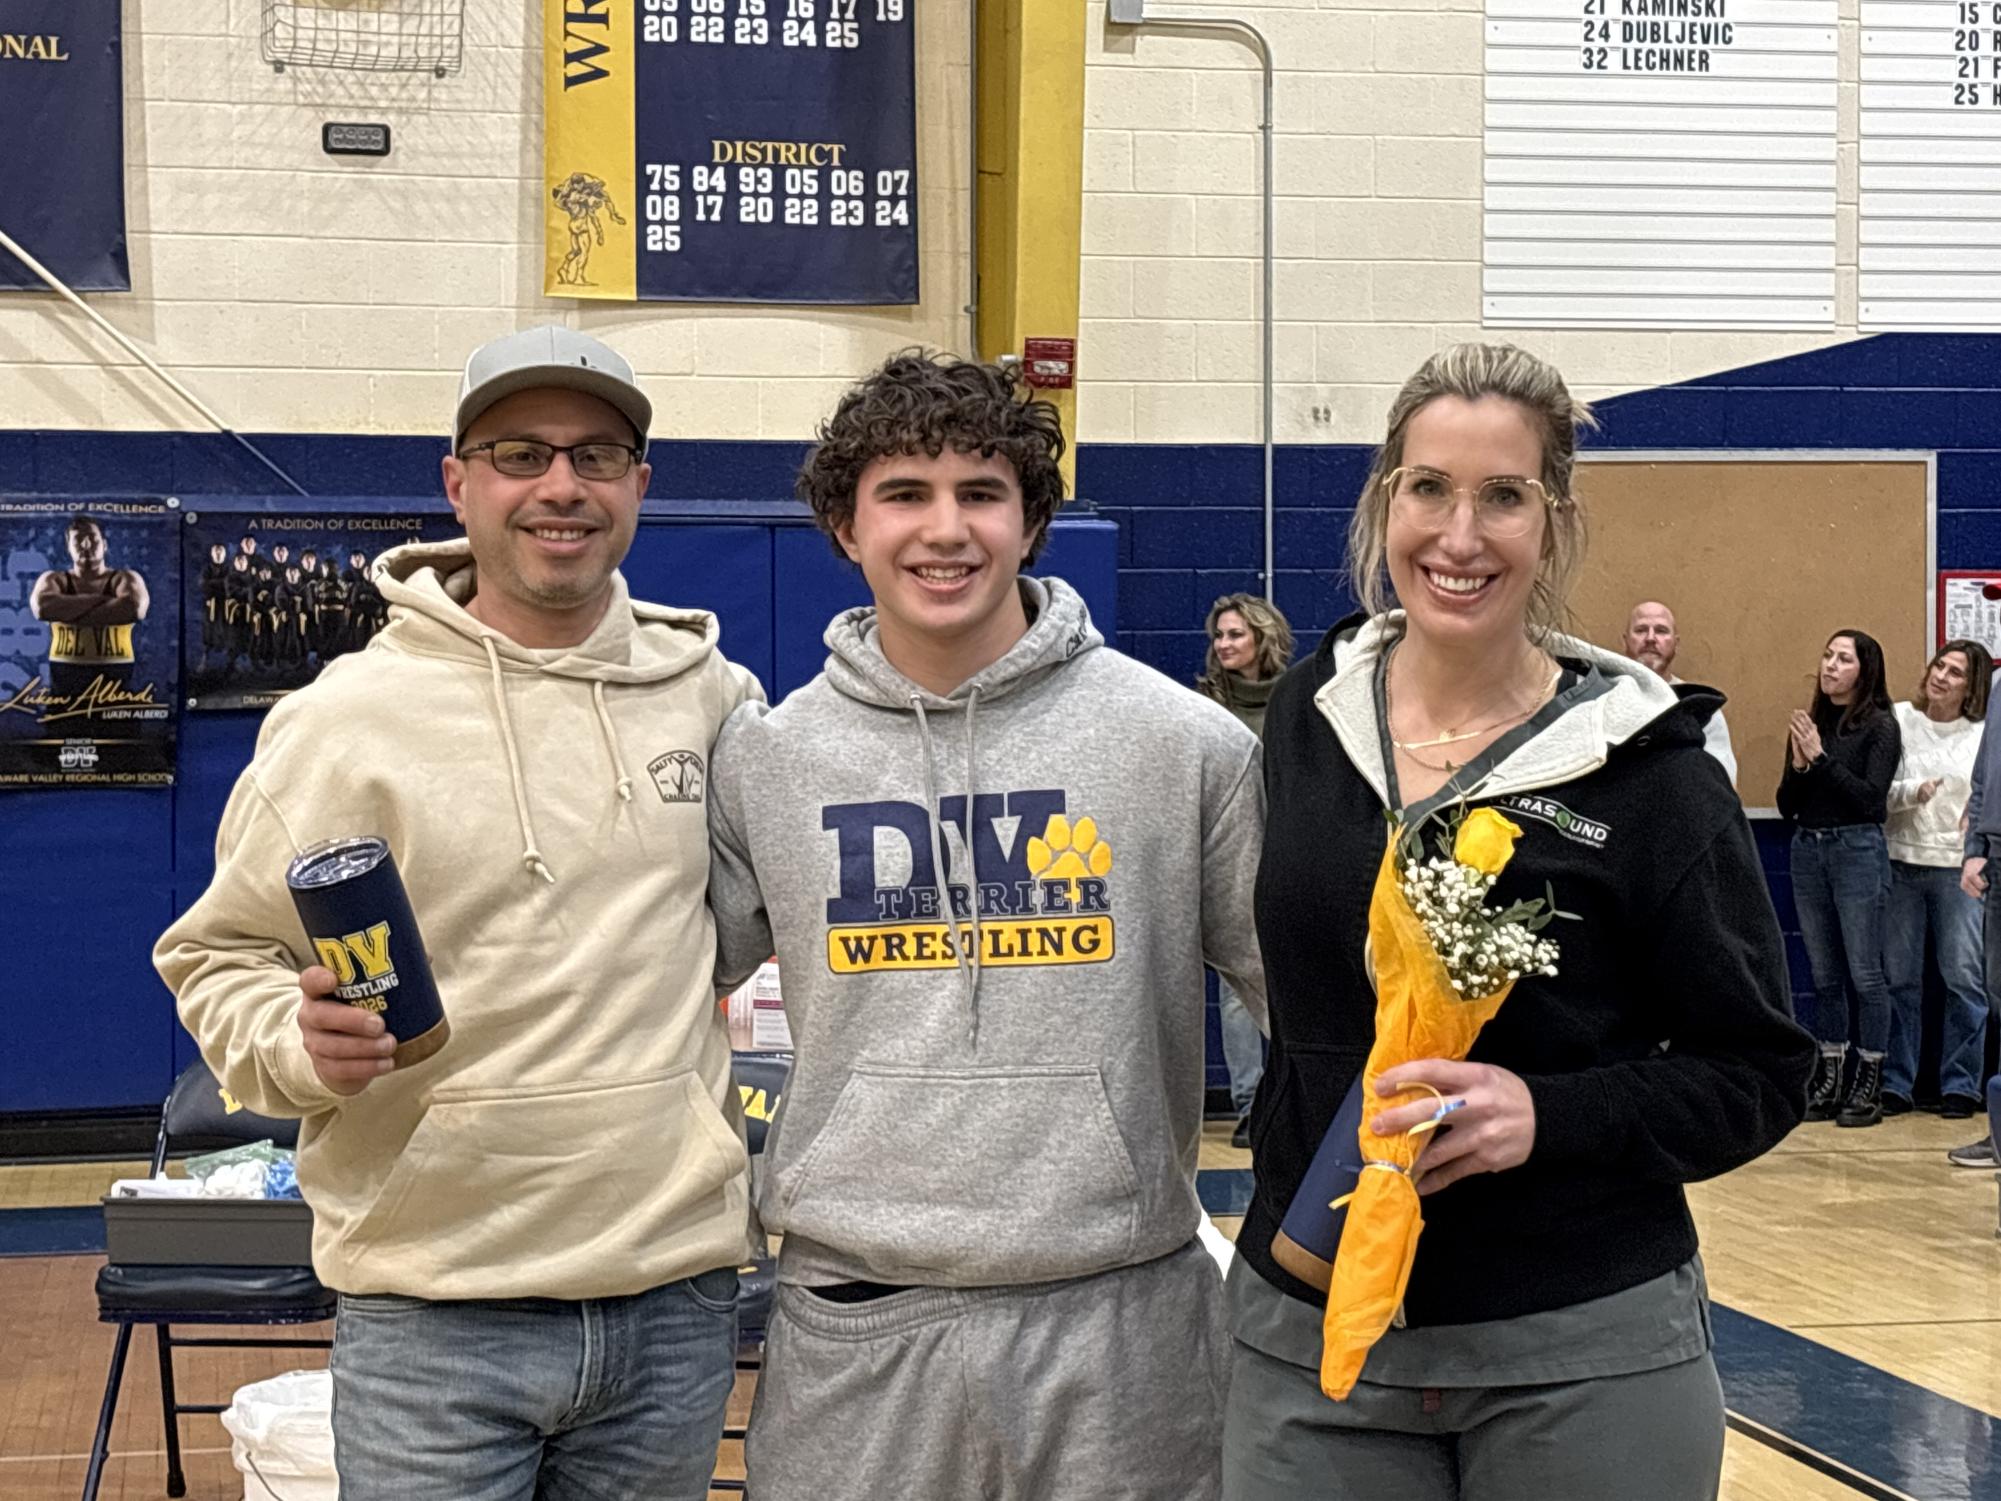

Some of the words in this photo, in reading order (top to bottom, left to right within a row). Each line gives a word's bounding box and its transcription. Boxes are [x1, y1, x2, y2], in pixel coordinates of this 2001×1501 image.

[739, 0, 765, 15] 15
[787, 0, 814, 18] 16
[830, 0, 857, 19] 17
[877, 0, 903, 21] 19
[1583, 0, 1605, 15] 21
[1621, 0, 1725, 18] KAMINSKI
[1959, 2, 1979, 24] 15
[644, 15, 678, 42] 20
[690, 16, 724, 43] 22
[735, 18, 768, 44] 23
[783, 20, 817, 46] 24
[826, 21, 859, 48] 25
[1583, 20, 1611, 43] 24
[1621, 20, 1733, 45] DUBLJEVIC
[1955, 29, 1979, 51] 20
[0, 34, 70, 61] NAL
[1582, 47, 1608, 70] 32
[1621, 48, 1710, 72] LECHNER
[1958, 56, 1979, 78] 21
[1954, 83, 1979, 105] 25
[712, 140, 846, 166] DISTRICT
[646, 165, 680, 191] 75
[693, 166, 726, 192] 84
[739, 167, 773, 193] 93
[785, 169, 818, 194] 05
[831, 170, 864, 195] 06
[877, 170, 910, 196] 07
[646, 195, 680, 221] 08
[695, 195, 723, 221] 17
[740, 196, 773, 222] 20
[785, 198, 818, 224] 22
[831, 199, 864, 226] 23
[875, 199, 909, 226] 24
[647, 225, 681, 251] 25
[68, 502, 85, 511] OF
[88, 502, 165, 513] EXCELLENCE
[248, 519, 258, 529] A
[261, 518, 324, 530] TRADITION
[331, 518, 344, 530] OF
[348, 518, 422, 530] EXCELLENCE
[55, 626, 86, 656] DEL
[93, 626, 124, 657] VAL
[102, 710, 131, 719] LUKEN
[31, 773, 63, 782] VALLEY
[65, 773, 111, 782] REGIONAL
[113, 773, 136, 782] HIGH
[138, 772, 168, 782] SCHOO
[1499, 796, 1608, 842] TRASOUND
[874, 877, 1111, 922] TERRIER
[312, 920, 395, 984] DV
[838, 924, 1101, 966] WRESTLING
